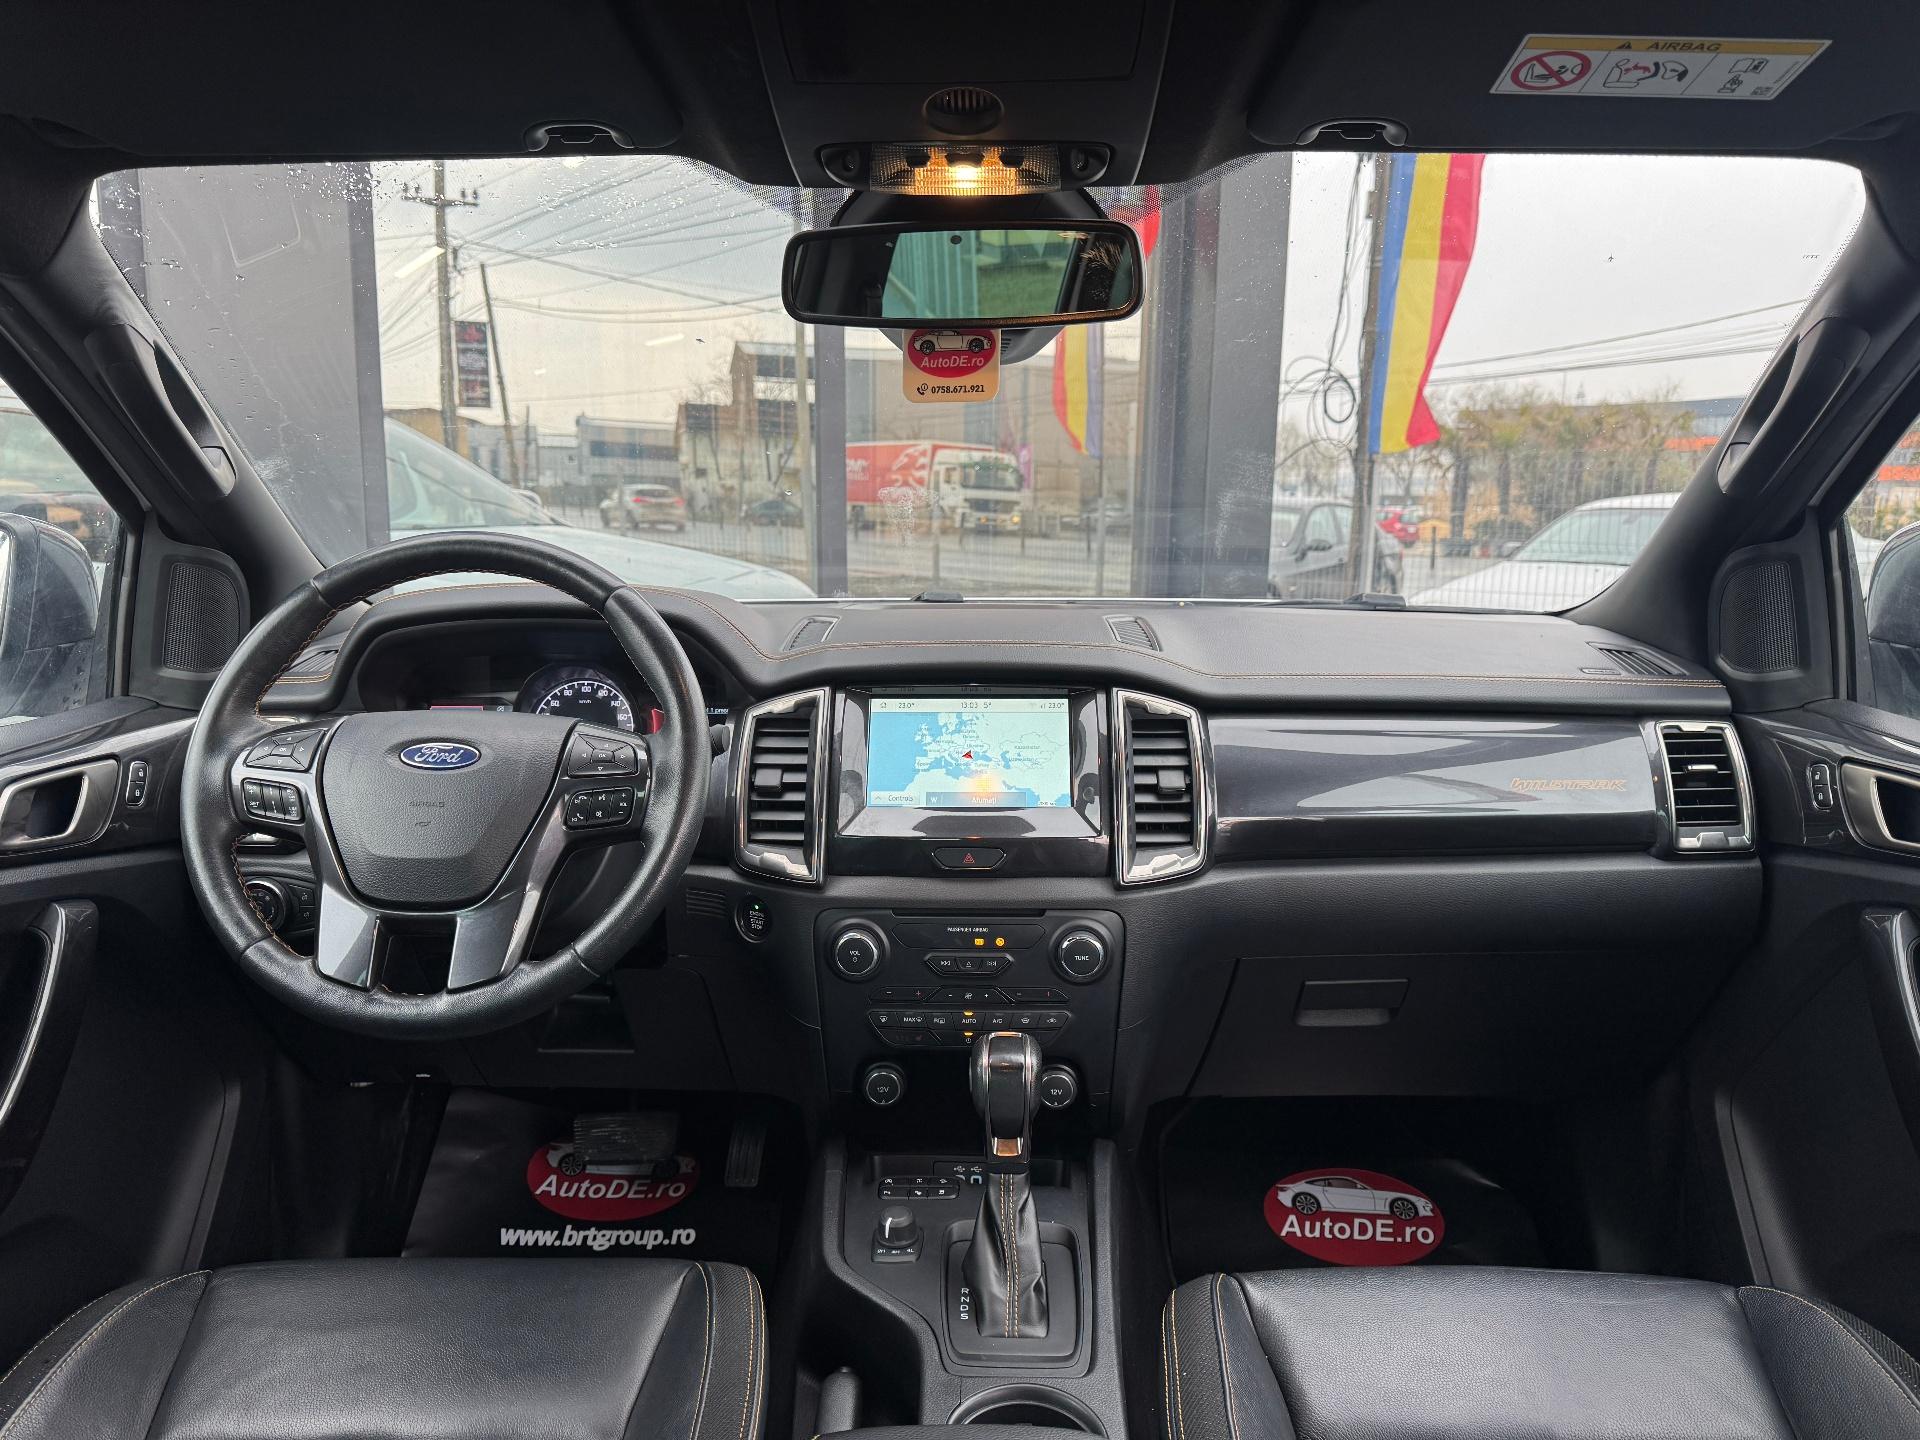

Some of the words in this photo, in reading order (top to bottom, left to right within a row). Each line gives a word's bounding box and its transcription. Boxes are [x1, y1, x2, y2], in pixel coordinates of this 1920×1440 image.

[1645, 41, 1723, 52] AIRBAG
[920, 355, 985, 368] AutoDE.ro
[931, 384, 985, 395] 0758.671.921
[414, 745, 464, 763] Ford
[1050, 1088, 1063, 1096] 12V
[535, 1174, 686, 1199] AutoDE.ro
[1280, 1214, 1435, 1245] AutoDE.ro
[500, 1224, 696, 1251] www.brtgroup.ro
